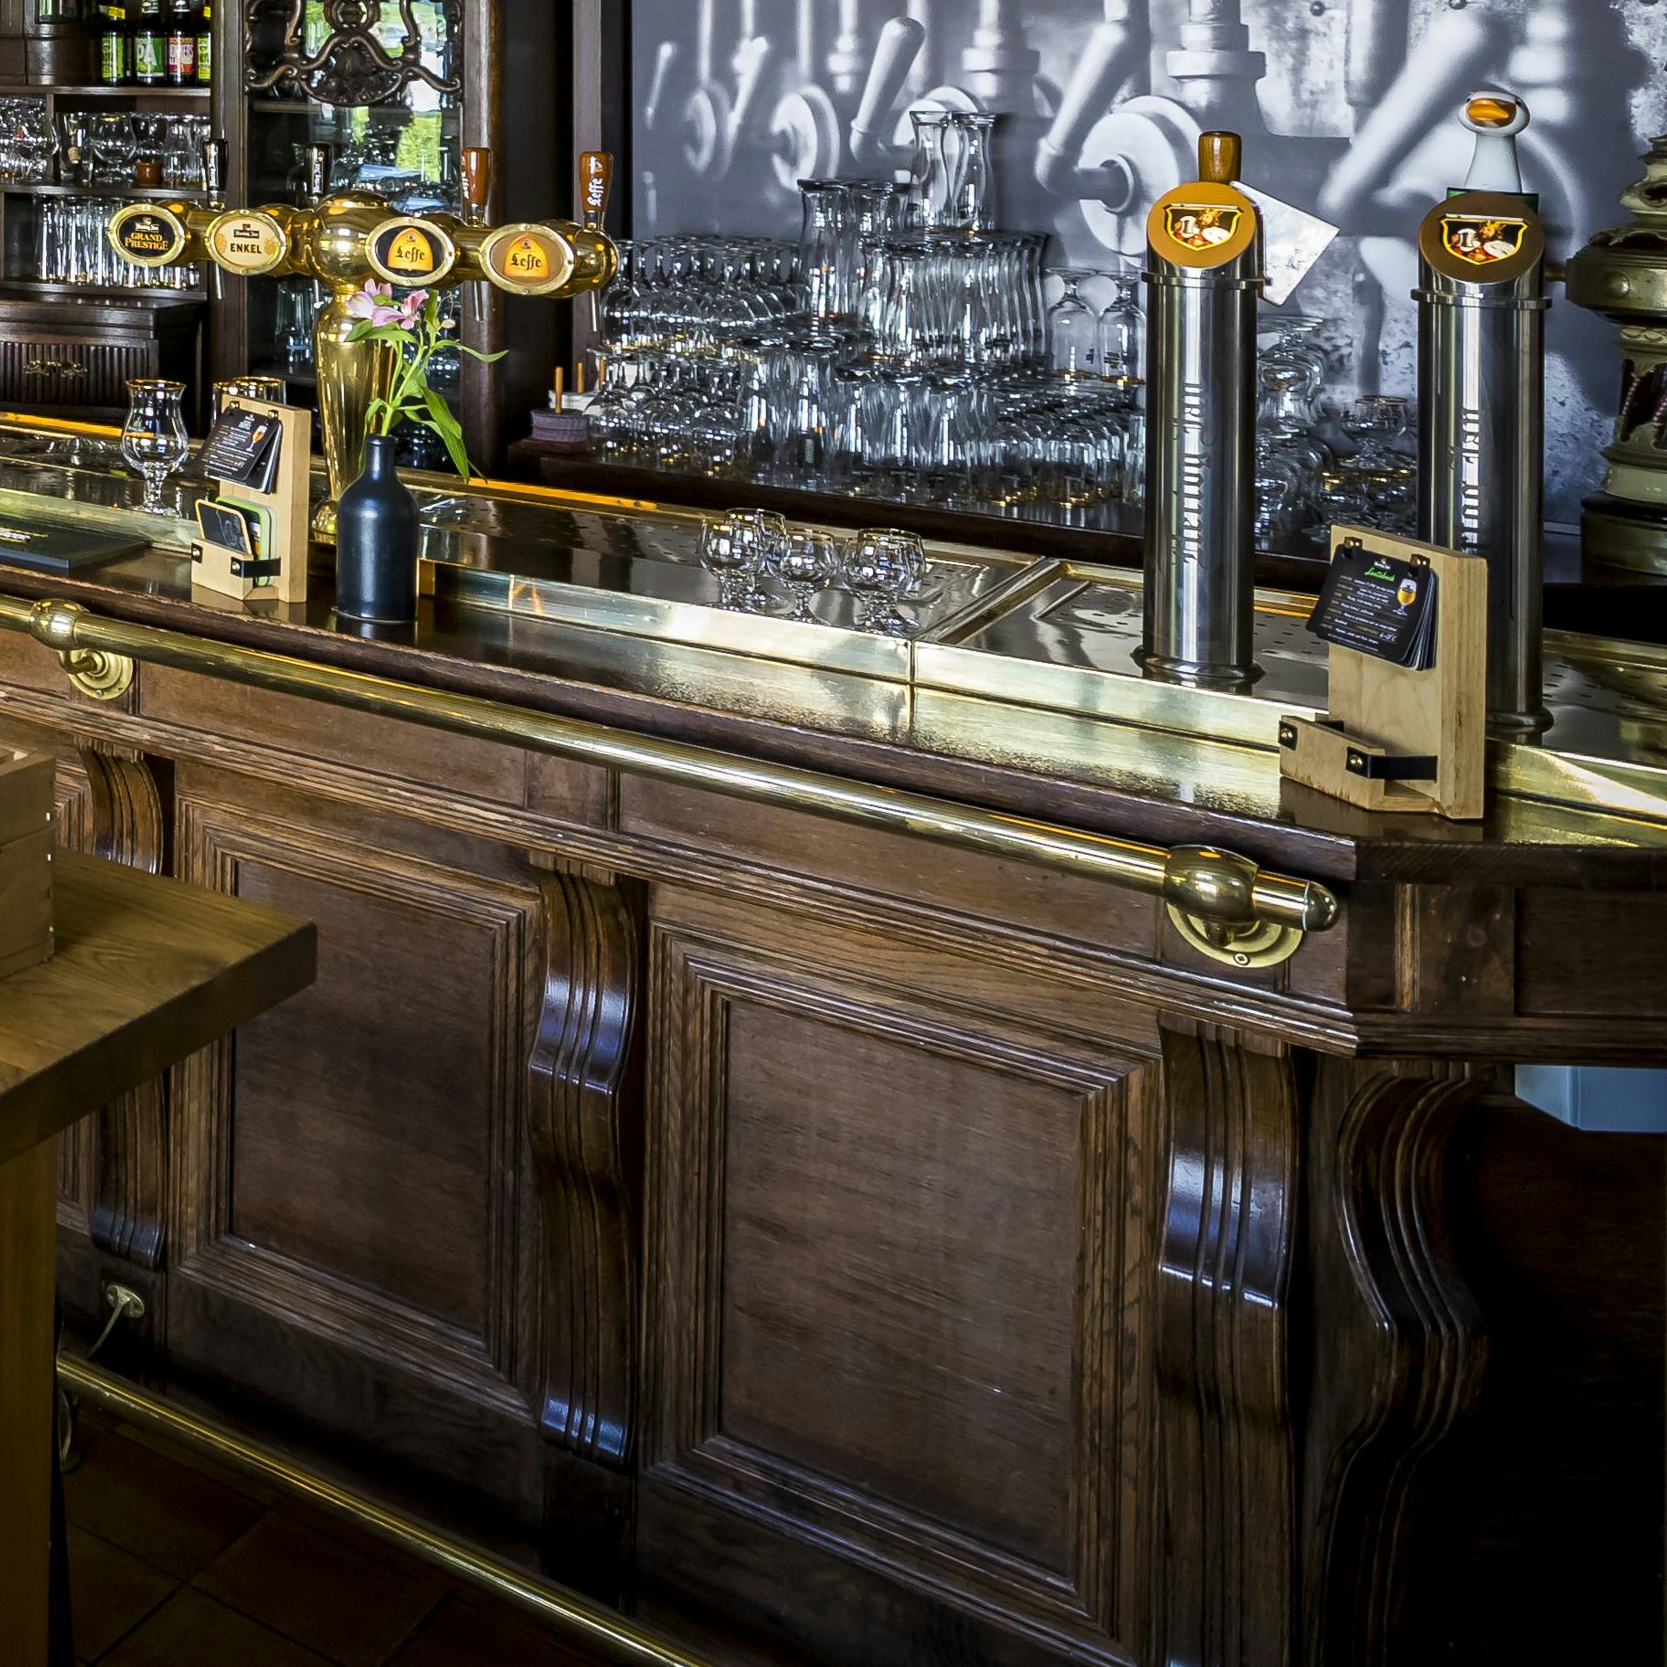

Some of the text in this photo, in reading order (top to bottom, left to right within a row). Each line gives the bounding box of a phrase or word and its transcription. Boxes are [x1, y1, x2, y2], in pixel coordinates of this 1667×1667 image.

[587, 177, 604, 207] Leffe
[130, 232, 163, 242] GRAND
[124, 240, 169, 250] PRESTIGE
[230, 242, 262, 254] ENKEL
[395, 245, 425, 263] Leffe
[510, 250, 542, 271] Leffe
